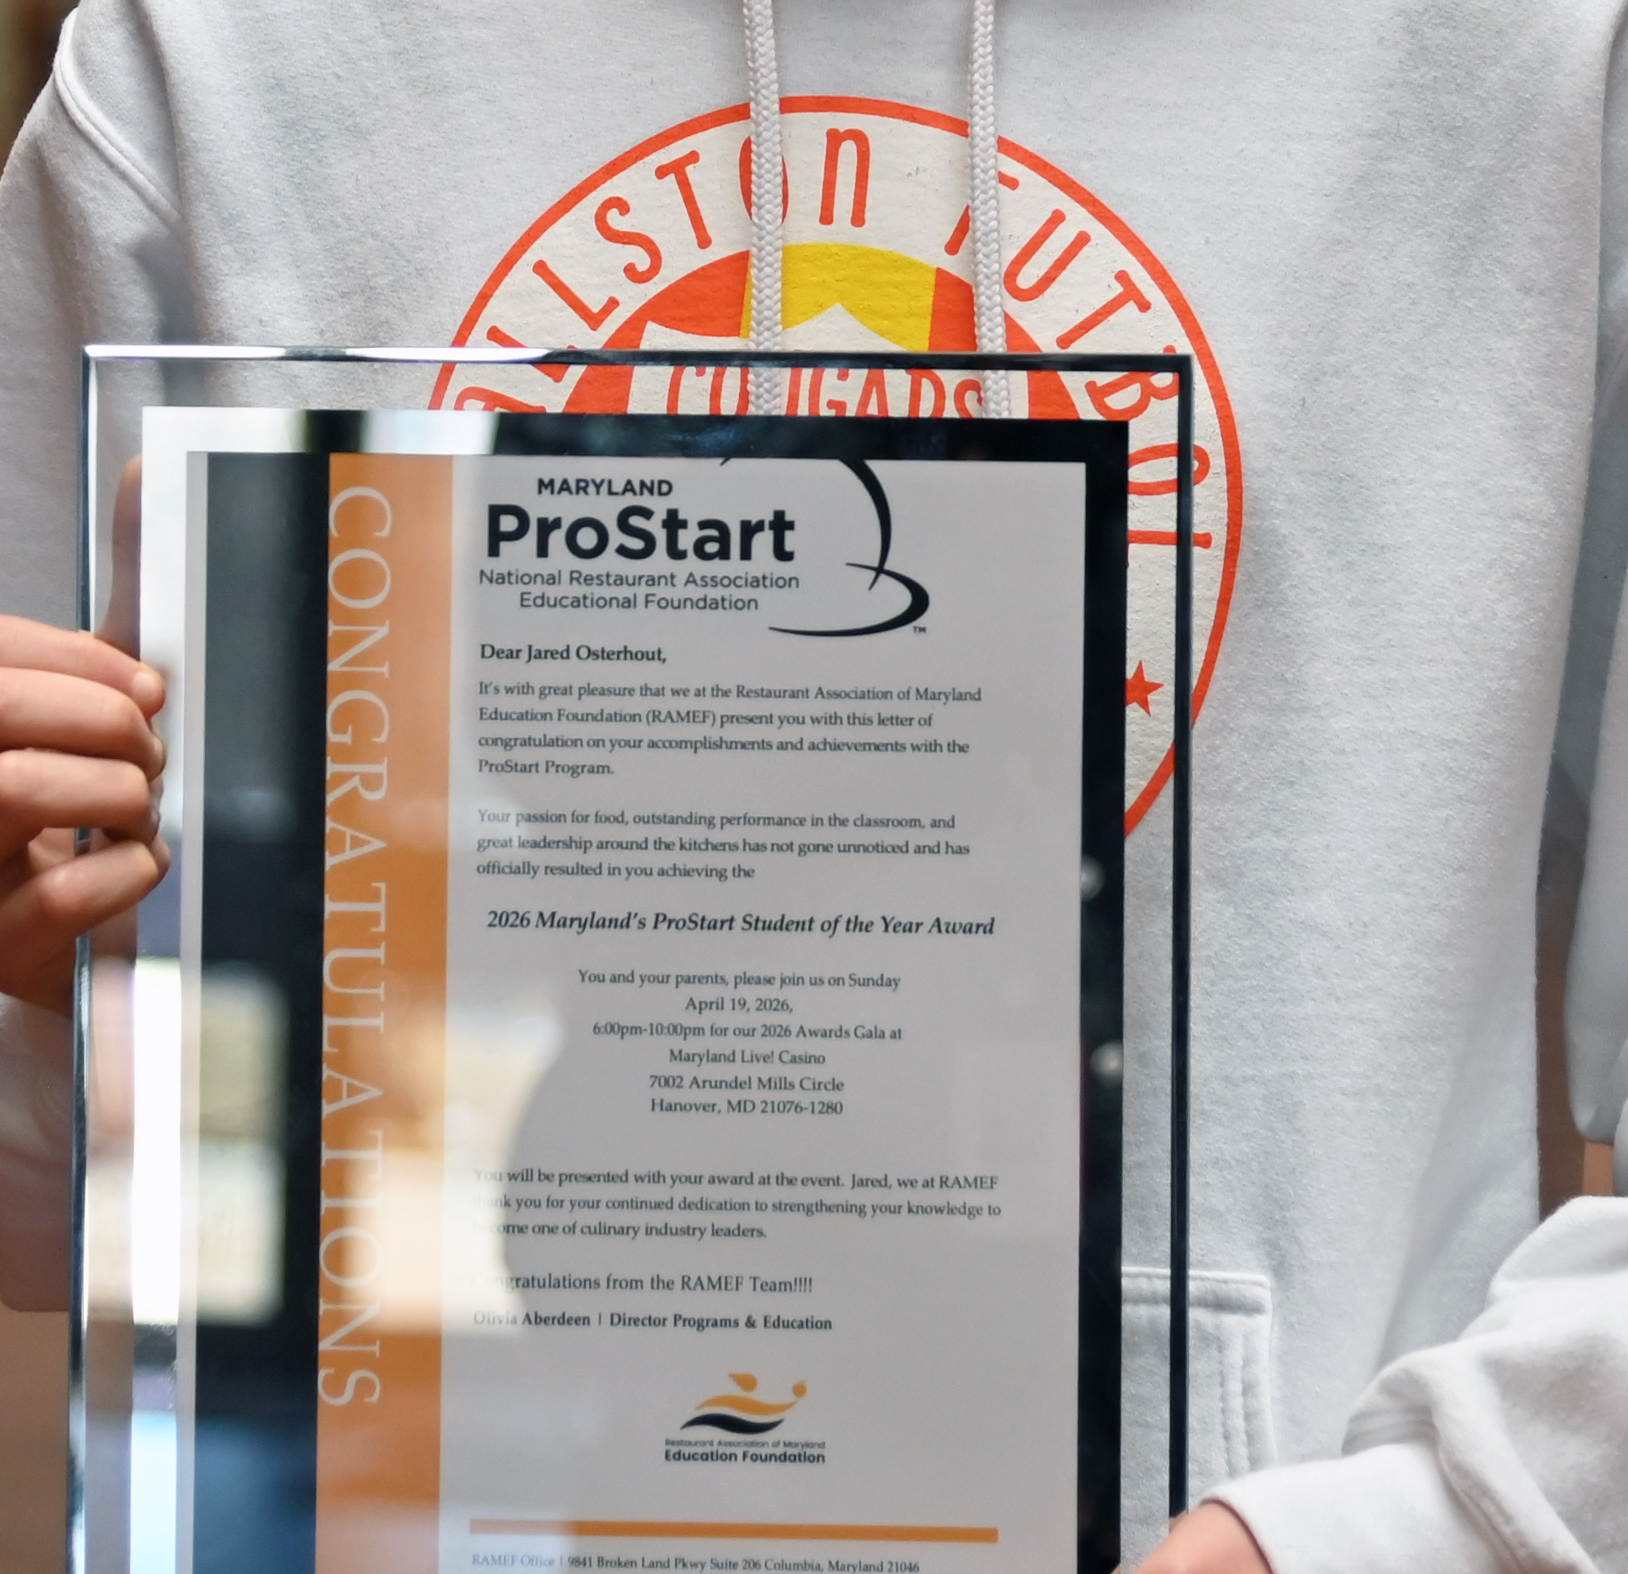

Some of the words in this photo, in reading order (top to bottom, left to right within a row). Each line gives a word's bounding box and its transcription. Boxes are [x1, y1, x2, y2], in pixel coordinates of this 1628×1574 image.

[536, 477, 674, 497] MARYLAND
[486, 503, 796, 563] ProStart
[478, 569, 562, 587] National
[568, 570, 678, 588] Restaurant
[683, 572, 801, 590] Association
[519, 592, 638, 610] Educational
[644, 594, 759, 611] Foundation
[479, 642, 524, 661] Dear
[524, 642, 572, 665] Jared
[574, 643, 668, 666] Osterhout,
[503, 680, 536, 697] with
[537, 683, 574, 702] great
[577, 681, 637, 702] pleasure
[638, 682, 667, 699] that
[669, 686, 692, 699] we
[710, 683, 733, 700] the
[735, 683, 811, 701] Restaurant
[813, 685, 894, 702] Association
[896, 685, 913, 702] of
[914, 685, 983, 707] Maryland
[478, 706, 554, 723] Education
[556, 707, 643, 725] Foundation
[645, 708, 717, 728] (RAMEF)
[719, 711, 775, 731] present
[776, 713, 807, 731] you
[809, 710, 844, 727] with
[846, 710, 875, 727] this
[876, 710, 916, 728] letter
[916, 711, 934, 728] of
[477, 733, 585, 753] congratulation
[585, 737, 607, 750] on
[608, 737, 645, 754] your
[646, 734, 774, 756] accomplishments
[775, 736, 805, 753] and
[806, 736, 908, 755] achievements
[909, 737, 944, 754] with
[946, 737, 971, 755] the
[477, 758, 540, 775] ProStart
[544, 759, 615, 780] Program.
[477, 808, 511, 823] Your
[515, 809, 568, 827] passion
[570, 808, 591, 825] for
[593, 808, 630, 828] food,
[632, 809, 717, 831] outstanding
[719, 811, 808, 832] performance
[810, 812, 825, 829] in
[827, 811, 850, 829] the
[852, 812, 926, 831] classroom,
[928, 813, 956, 830] and
[476, 837, 513, 854] great
[517, 834, 594, 856] leadership
[595, 835, 650, 852] around
[652, 835, 677, 853] the
[678, 835, 741, 854] kitchens
[741, 837, 769, 854] has
[769, 839, 795, 854] not
[796, 842, 835, 859] gone
[836, 839, 910, 856] unnoticed
[912, 839, 942, 856] and
[943, 839, 971, 856] has
[475, 859, 541, 880] officially
[543, 860, 604, 877] resulted
[606, 861, 623, 877] in
[624, 865, 655, 883] you
[656, 861, 729, 884] achieving
[731, 863, 756, 880] the
[486, 909, 532, 930] 2026
[651, 911, 738, 933] ProStart
[740, 912, 817, 934] Student
[819, 913, 844, 940] of
[844, 913, 875, 935] the
[879, 913, 925, 936] Year
[926, 915, 996, 937] Award
[317, 485, 394, 1407] CONGRATULATIONS
[577, 968, 607, 985] You
[608, 969, 636, 986] and
[638, 973, 672, 990] your
[674, 972, 730, 990] parents,
[733, 970, 777, 992] please
[779, 971, 806, 991] join
[827, 975, 846, 988] on
[847, 971, 902, 994] Sunday
[684, 995, 725, 1016] April
[730, 996, 751, 1014] 19,
[754, 996, 794, 1014] 2026,
[592, 1020, 706, 1042] 6:00pm-10:00pm
[709, 1021, 730, 1039] for
[732, 1026, 758, 1039] our
[760, 1022, 793, 1039] 2026
[795, 1023, 852, 1041] Awards
[852, 1023, 887, 1041] Gala
[668, 1047, 737, 1068] Maryland
[740, 1048, 775, 1065] Live!
[777, 1048, 827, 1066] Casino
[648, 1073, 685, 1090] 7002
[687, 1074, 753, 1092] Arundel
[756, 1074, 796, 1092] Mills
[798, 1075, 845, 1093] Circle
[650, 1097, 722, 1116] Hanover,
[725, 1098, 757, 1115] MD
[759, 1098, 844, 1116] 21076-1280
[506, 1167, 535, 1184] will
[537, 1168, 556, 1185] be
[558, 1169, 630, 1189] presented
[632, 1168, 667, 1186] with
[669, 1172, 705, 1190] your
[707, 1169, 755, 1187] award
[774, 1170, 799, 1188] the
[800, 1173, 845, 1189] event.
[850, 1172, 893, 1191] Jared,
[895, 1177, 919, 1190] we
[938, 1173, 999, 1192] RAMEF
[514, 1196, 543, 1214] you
[545, 1194, 566, 1210] for
[568, 1198, 602, 1215] your
[604, 1195, 675, 1212] continued
[677, 1195, 751, 1213] dedication
[770, 1198, 868, 1220] strengthening
[870, 1202, 904, 1219] your
[906, 1199, 984, 1221] knowledge
[531, 1223, 560, 1237] one
[561, 1220, 578, 1237] of
[579, 1220, 642, 1242] culinary
[644, 1221, 708, 1242] industry
[710, 1221, 768, 1240] leaders.
[605, 1271, 645, 1292] from
[649, 1272, 676, 1292] the
[680, 1273, 745, 1294] RAMEF
[748, 1274, 813, 1295] Team!!!!
[521, 1309, 592, 1328] Aberdeen
[609, 1312, 669, 1329] Director
[673, 1313, 740, 1333] Programs
[744, 1313, 758, 1331] &
[762, 1313, 833, 1332] Education
[664, 1449, 738, 1463] Education
[742, 1450, 826, 1465] Foundation
[566, 1554, 593, 1570] 9841
[596, 1554, 638, 1571] Broken
[641, 1555, 671, 1571] Land
[709, 1556, 740, 1572] Suite
[741, 1557, 762, 1572] 206
[763, 1557, 825, 1573] Columbia,
[827, 1558, 884, 1573] Maryland
[887, 1560, 921, 1573] 21046
